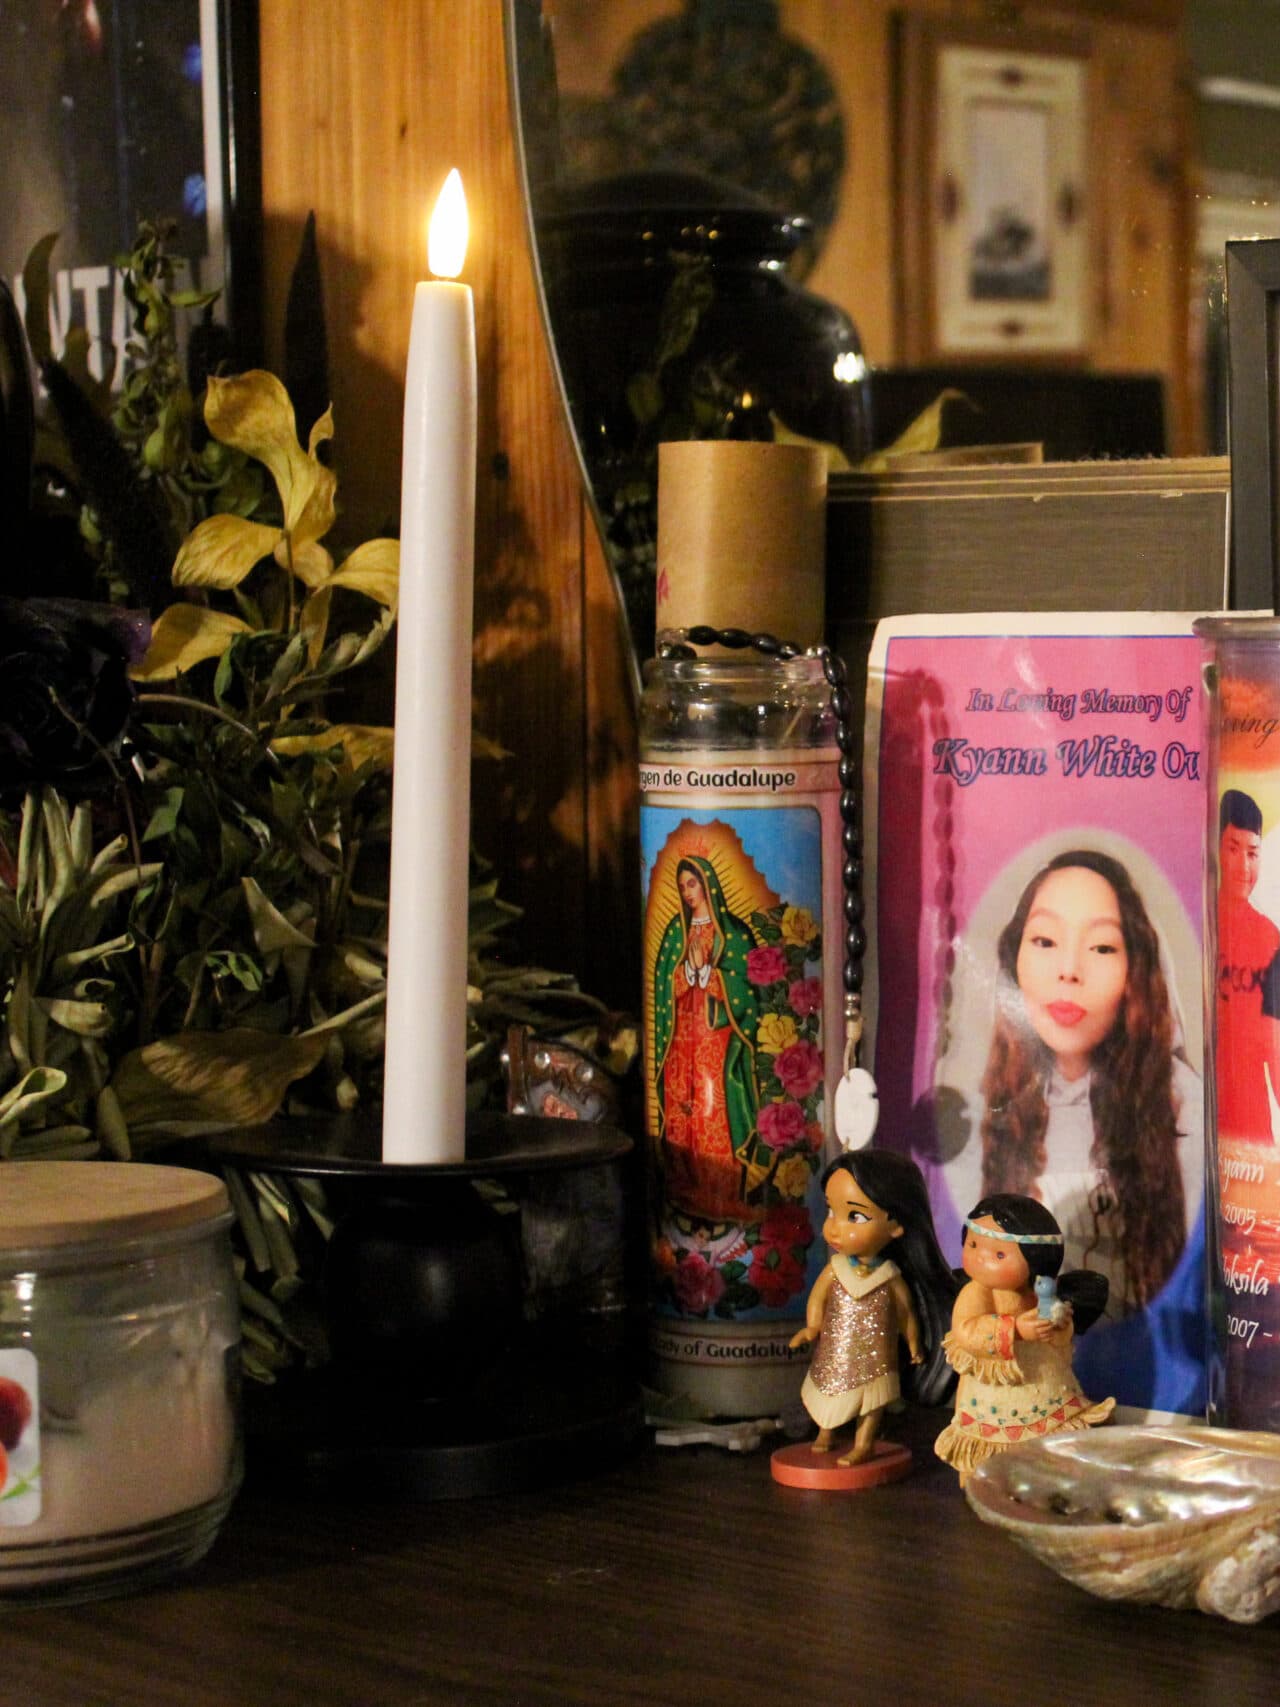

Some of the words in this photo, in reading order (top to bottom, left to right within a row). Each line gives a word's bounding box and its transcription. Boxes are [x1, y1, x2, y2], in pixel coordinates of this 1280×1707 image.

[966, 688, 994, 712] In
[997, 687, 1076, 721] Loving
[1080, 688, 1163, 722] Memory
[1165, 686, 1194, 722] Of
[932, 737, 1048, 787] Kyann
[1056, 735, 1156, 778] White
[640, 771, 660, 790] gen
[663, 769, 682, 785] de
[687, 769, 796, 791] Guadalupe
[1219, 1154, 1265, 1193] yann
[1224, 1203, 1257, 1235] 2005
[684, 1340, 704, 1356] of
